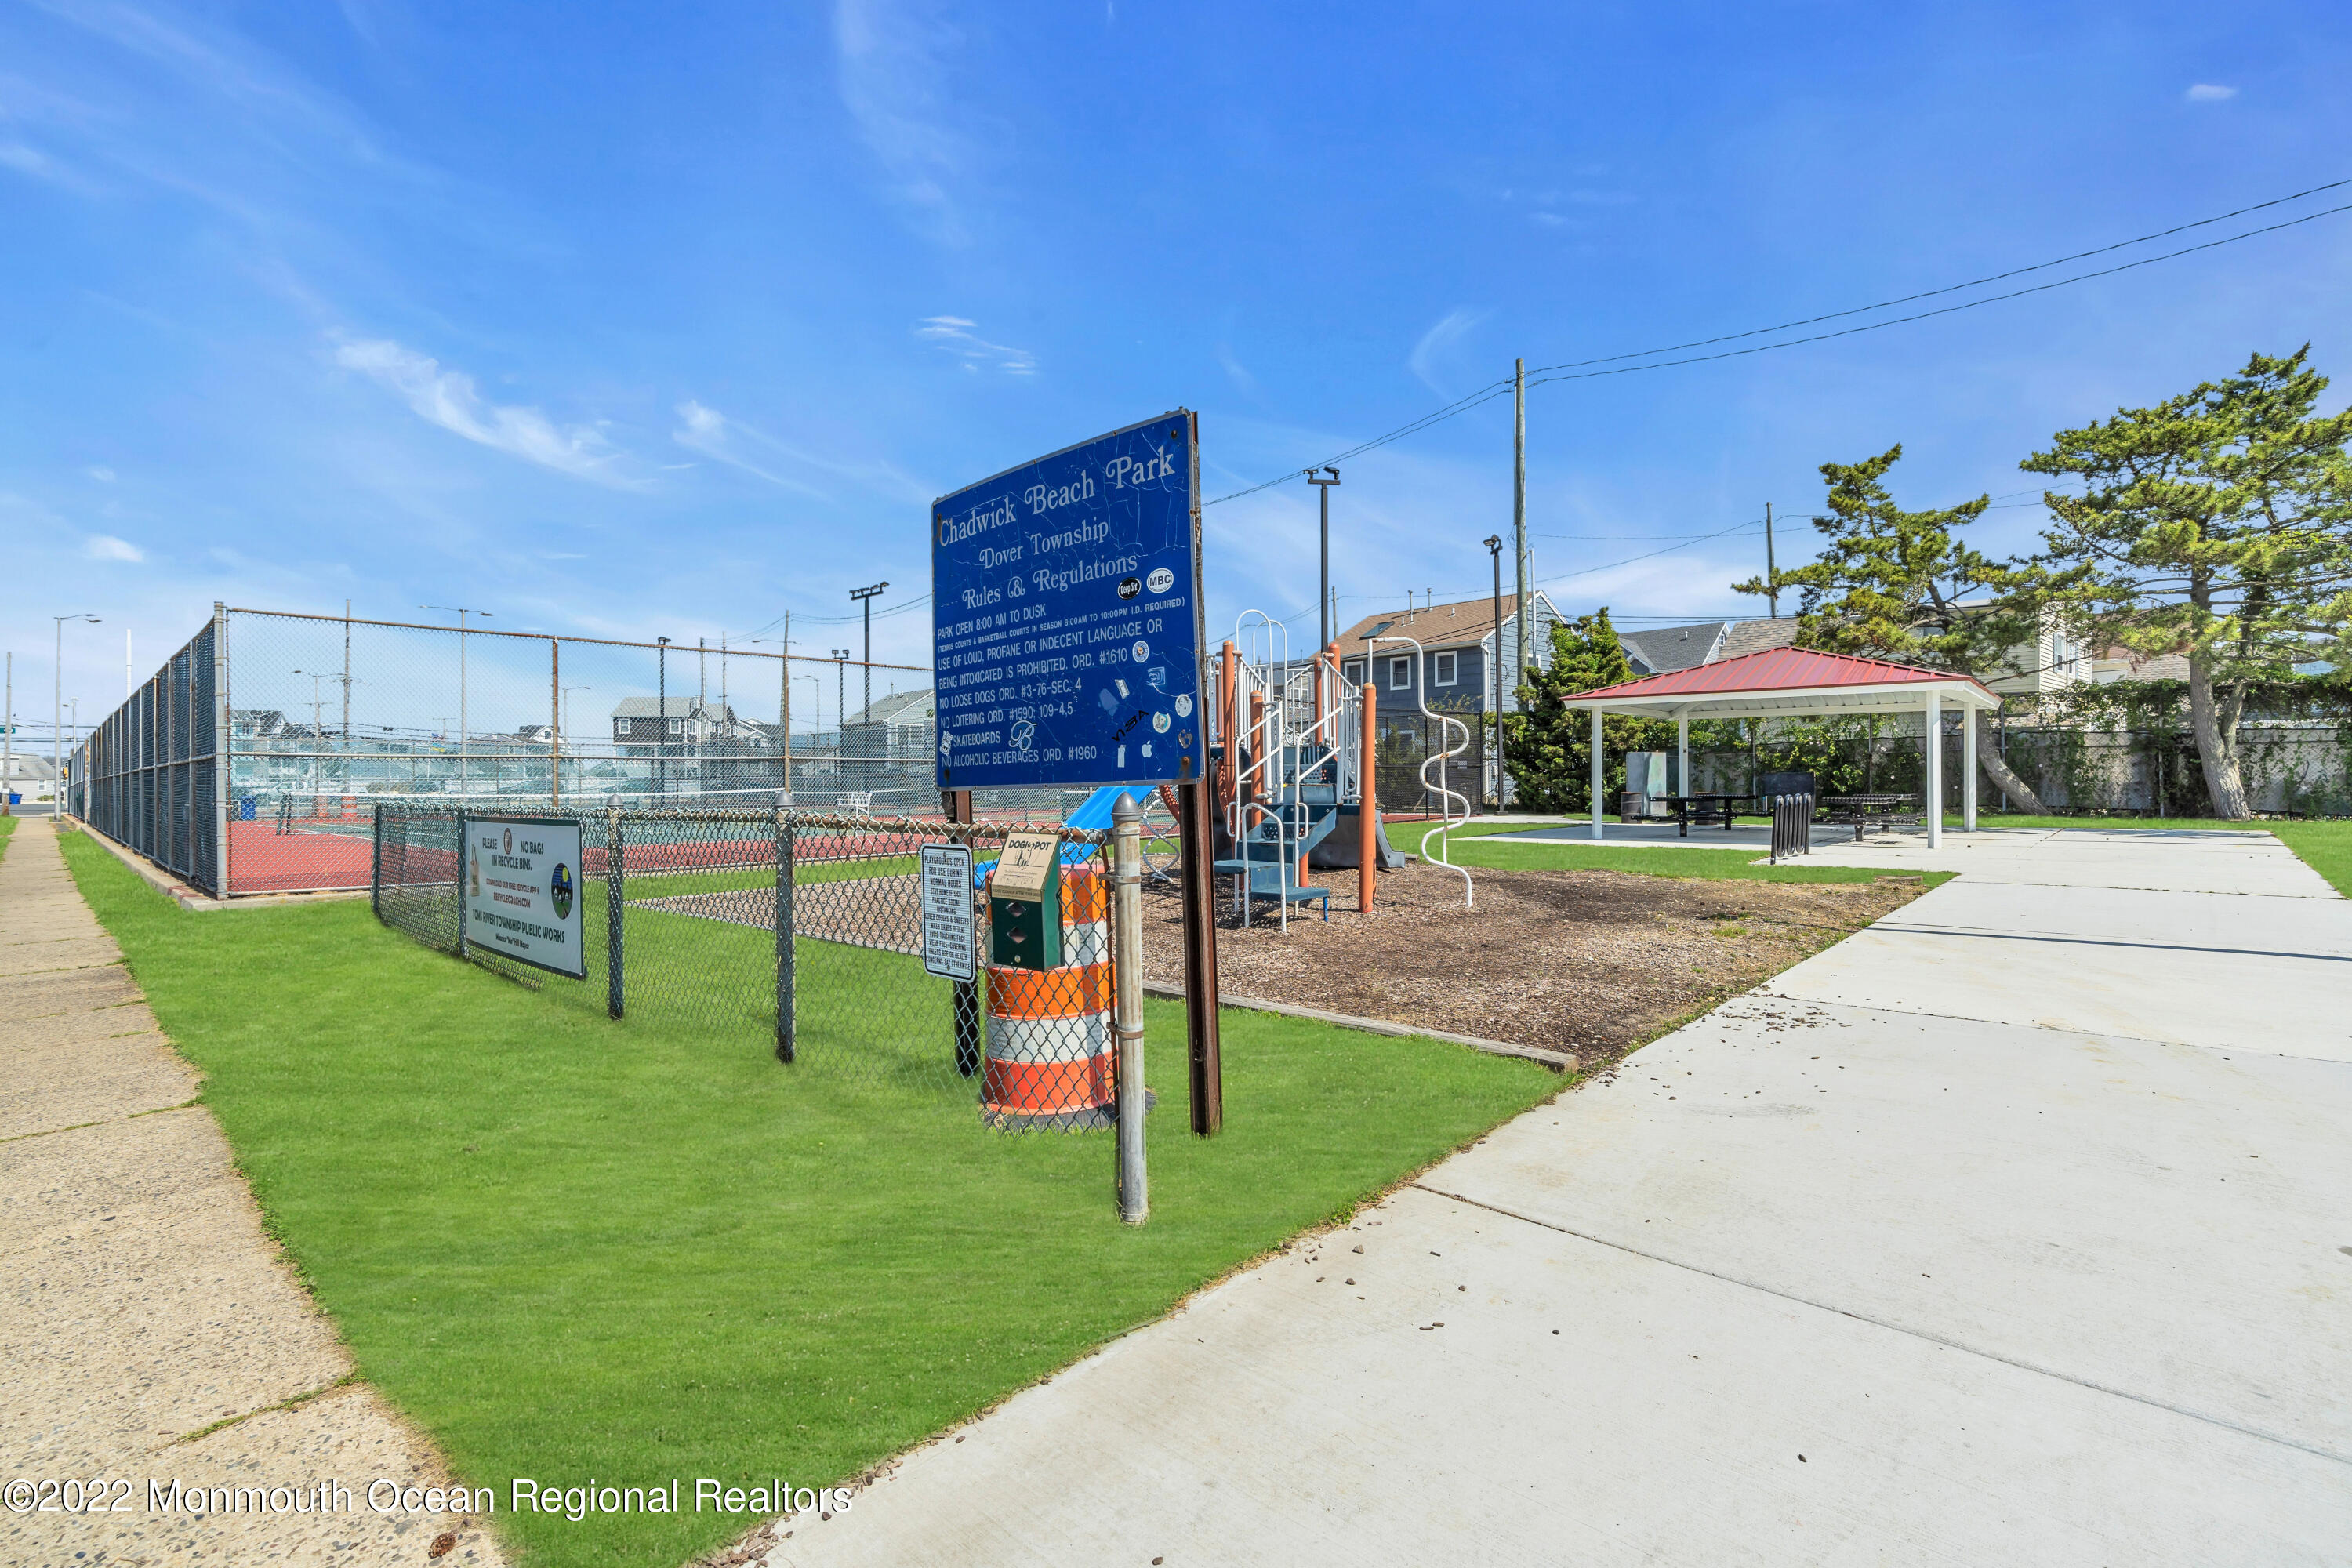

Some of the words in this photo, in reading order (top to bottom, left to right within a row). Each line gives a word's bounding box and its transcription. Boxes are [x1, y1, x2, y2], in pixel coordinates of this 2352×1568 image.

[939, 495, 1016, 546] Chadwick
[1025, 470, 1094, 515] Beach
[1106, 445, 1175, 489] Park
[979, 546, 1023, 569] Dover
[1031, 517, 1109, 555] Township
[963, 586, 1000, 609] Rules
[1008, 576, 1025, 599] &
[1033, 556, 1137, 592] Regulations
[1149, 574, 1171, 586] MBC
[938, 626, 953, 640] PARK
[956, 621, 974, 635] OPEN
[976, 615, 992, 630] 8:00
[995, 612, 1006, 626] AM
[1010, 609, 1020, 623] TO
[1023, 604, 1047, 620] DUSK
[955, 639, 971, 650] COURTS
[978, 631, 1007, 644] BASKETBALL
[1009, 626, 1029, 637] COURTS
[1040, 619, 1062, 632] SEASON
[1064, 615, 1087, 626] 8:00AM
[1090, 613, 1098, 622] TO
[1101, 608, 1128, 619] 10:00PM
[1131, 606, 1142, 615] I.D.
[1145, 596, 1185, 612] REQUIRED)
[938, 657, 950, 670] USE
[953, 655, 962, 666] OF
[987, 643, 1021, 661] PROFANE
[1025, 640, 1036, 654] OR
[1040, 631, 1083, 651] INDECENT
[1087, 622, 1142, 644] LANGUAGE
[1147, 618, 1163, 634] OR
[939, 676, 957, 689] BEING
[960, 667, 1003, 686] INTOXICATED
[1006, 666, 1013, 678] IS
[1017, 657, 1068, 676] PROHIBITED.
[1073, 653, 1094, 668] ORD.
[1099, 648, 1128, 664] #1610
[940, 697, 949, 710] NO
[951, 693, 972, 708] LOOSE
[975, 690, 996, 704] DOGS
[999, 687, 1017, 701] ORD.
[1022, 678, 1072, 698] #3-76-SEC.
[1075, 677, 1082, 691] 4
[941, 717, 950, 729] NO
[952, 713, 985, 728] LOITERING
[988, 710, 1005, 723] ORD.
[1039, 702, 1073, 718] 109-4,5
[953, 731, 1001, 747] SKATEBOARDS
[942, 756, 951, 768] NO
[953, 753, 989, 767] ALCOHOLIC
[993, 750, 1039, 765] BEVERAGES
[1043, 748, 1064, 762] ORD.
[1068, 746, 1097, 760] #1960
[482, 837, 497, 850] PLEASE
[521, 841, 528, 853] NO
[530, 842, 544, 855] BAGS
[492, 855, 497, 866] IN
[498, 855, 519, 869] RECYCLE
[519, 858, 532, 871] BINS.
[925, 855, 953, 866] PLAYGROUNDS
[954, 858, 965, 866] OPEN
[931, 878, 946, 887] NORMAL
[948, 880, 961, 888] HOURS
[938, 867, 946, 876] USE
[947, 868, 963, 877] DURING
[517, 883, 529, 893] RECYCLE
[473, 909, 482, 921] TOMS
[483, 912, 495, 926] RIVER
[495, 915, 521, 932] TOWNSHIP
[522, 922, 542, 938] PUBLIC
[543, 927, 564, 943] WORKS
[954, 916, 969, 925] SNEEZES
[940, 932, 956, 941] TOUCHING
